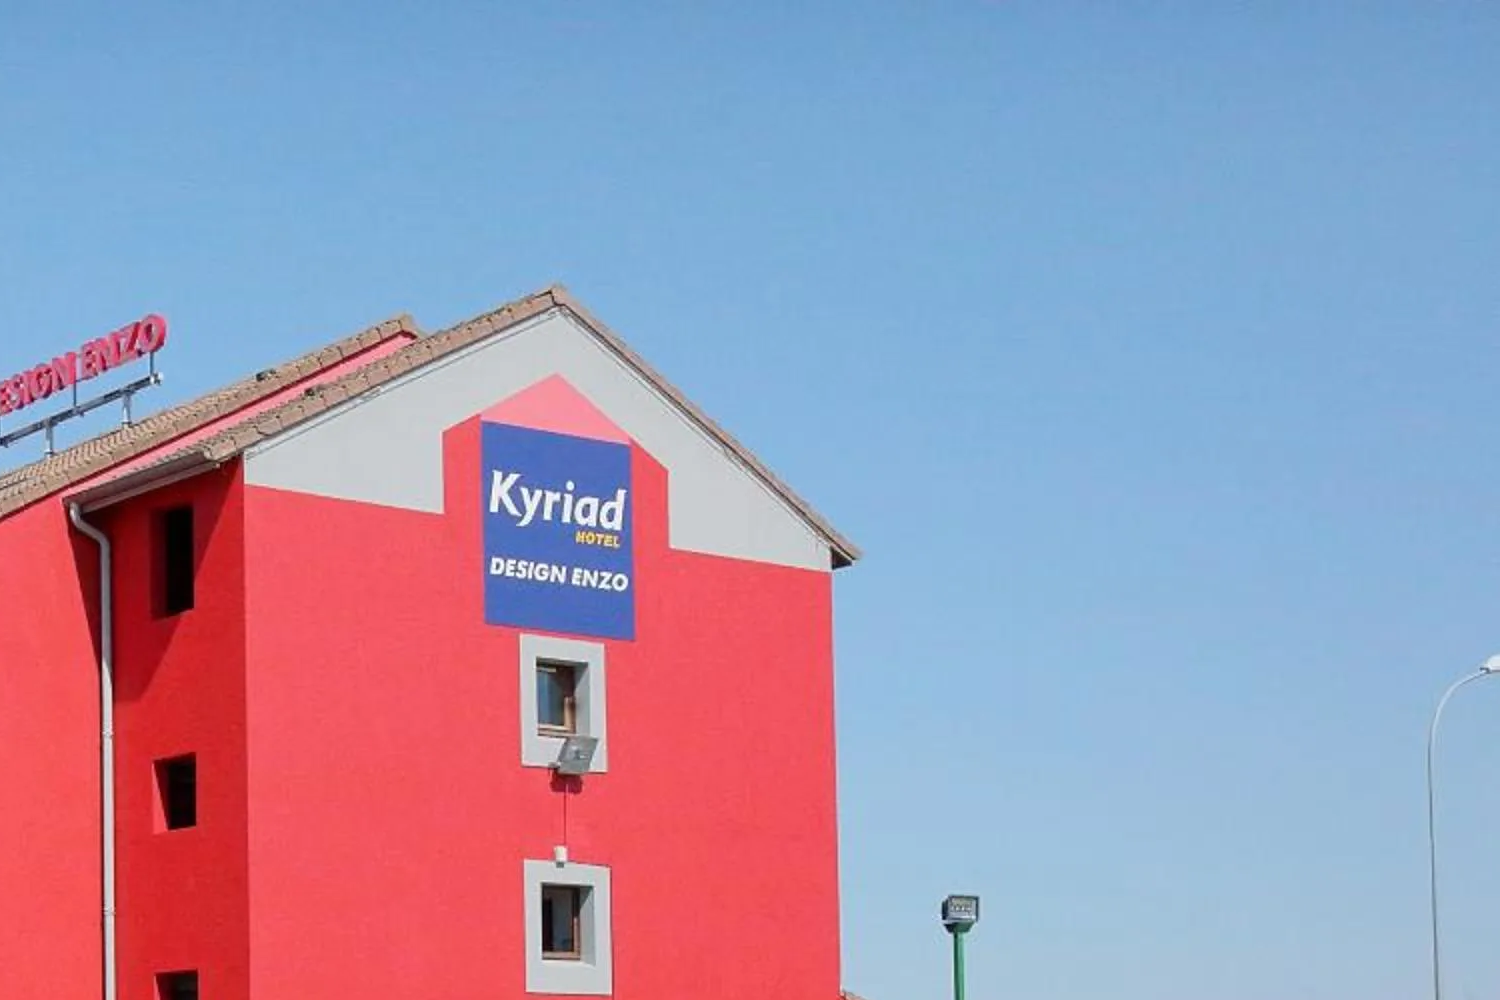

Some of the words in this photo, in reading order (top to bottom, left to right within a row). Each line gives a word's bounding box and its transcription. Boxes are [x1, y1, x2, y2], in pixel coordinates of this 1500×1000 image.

[81, 313, 168, 379] ENZO
[489, 469, 628, 531] Kyriad
[575, 531, 621, 548] HOTEL
[489, 557, 567, 584] DESIGN
[571, 568, 629, 592] ENZO
